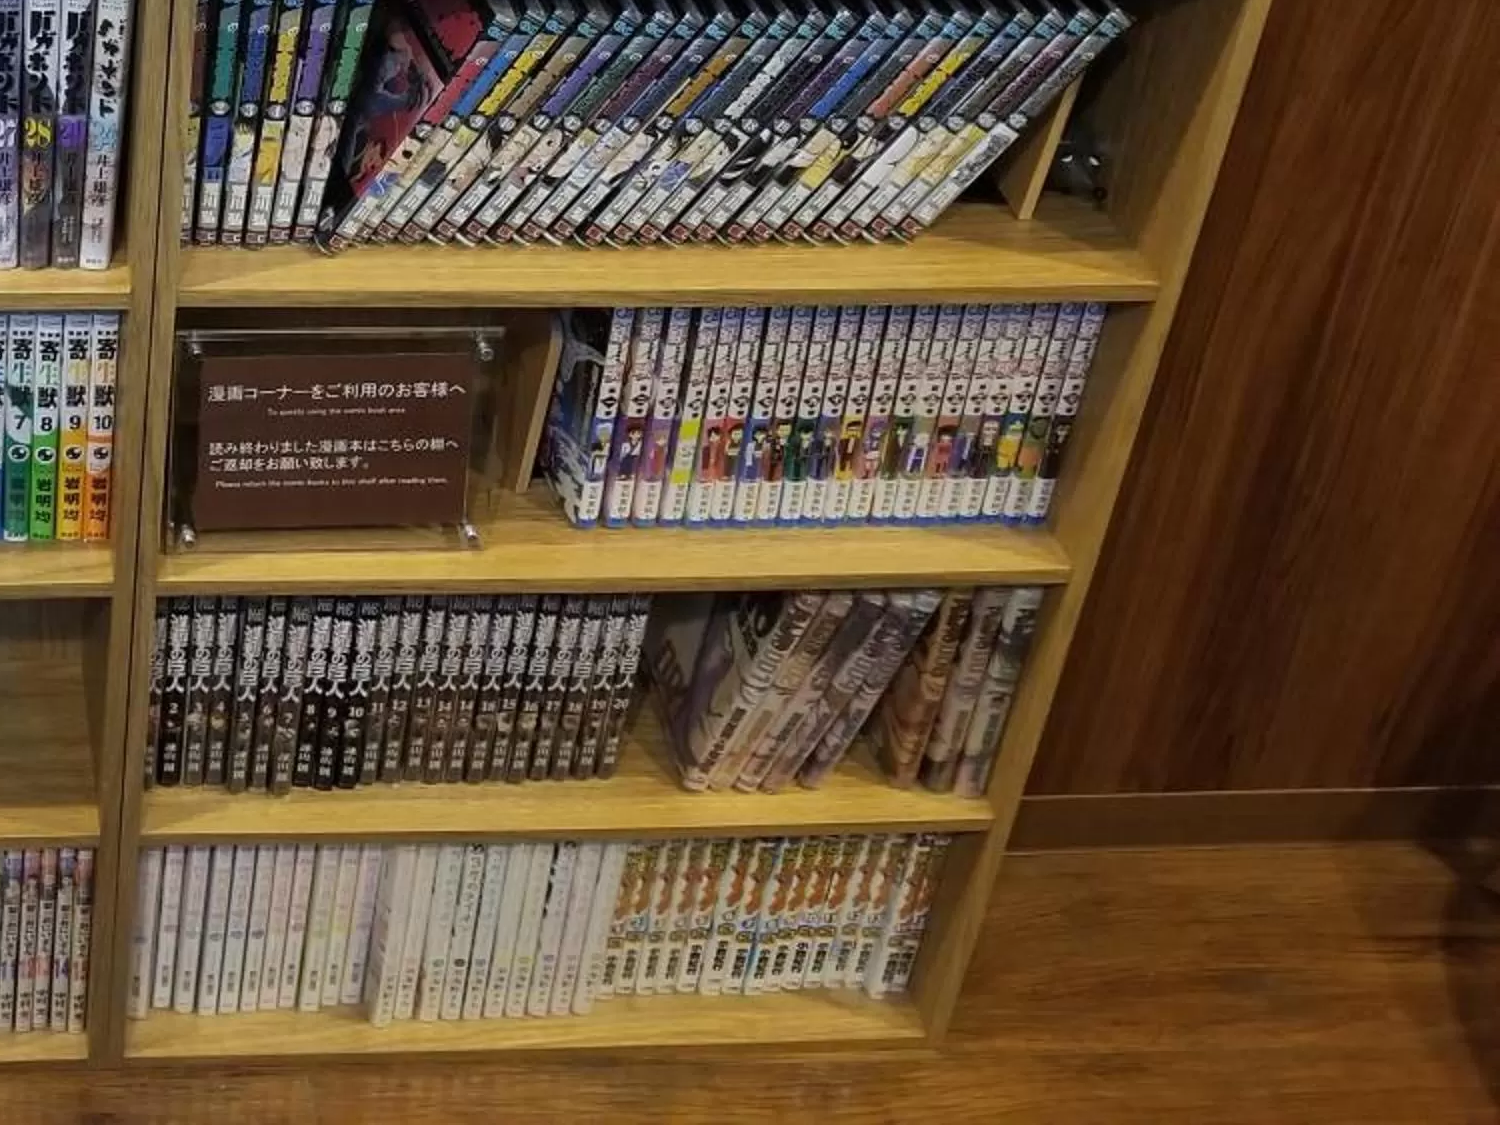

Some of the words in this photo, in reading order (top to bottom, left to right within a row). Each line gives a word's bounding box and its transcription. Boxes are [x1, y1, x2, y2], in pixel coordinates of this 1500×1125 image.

[38, 340, 60, 409] 寄生獣
[67, 338, 89, 407] 寄生獣
[208, 381, 467, 402] 漫画コーナーをご利用のお客様へ
[40, 415, 53, 430] 8
[68, 414, 81, 429] 9
[93, 415, 113, 430] 10
[209, 456, 369, 472] ご返却をお願い致します。
[215, 480, 241, 488] Please
[36, 478, 52, 523] 岩明均
[63, 476, 81, 520] 岩明均
[90, 476, 107, 521] 岩明均
[166, 613, 190, 693] 進撃の巨人
[305, 615, 333, 694] 進撃の巨人
[326, 620, 352, 700] 進撃の巨人
[349, 618, 377, 698] 進撃の巨人
[392, 612, 422, 691] 進撃の巨人
